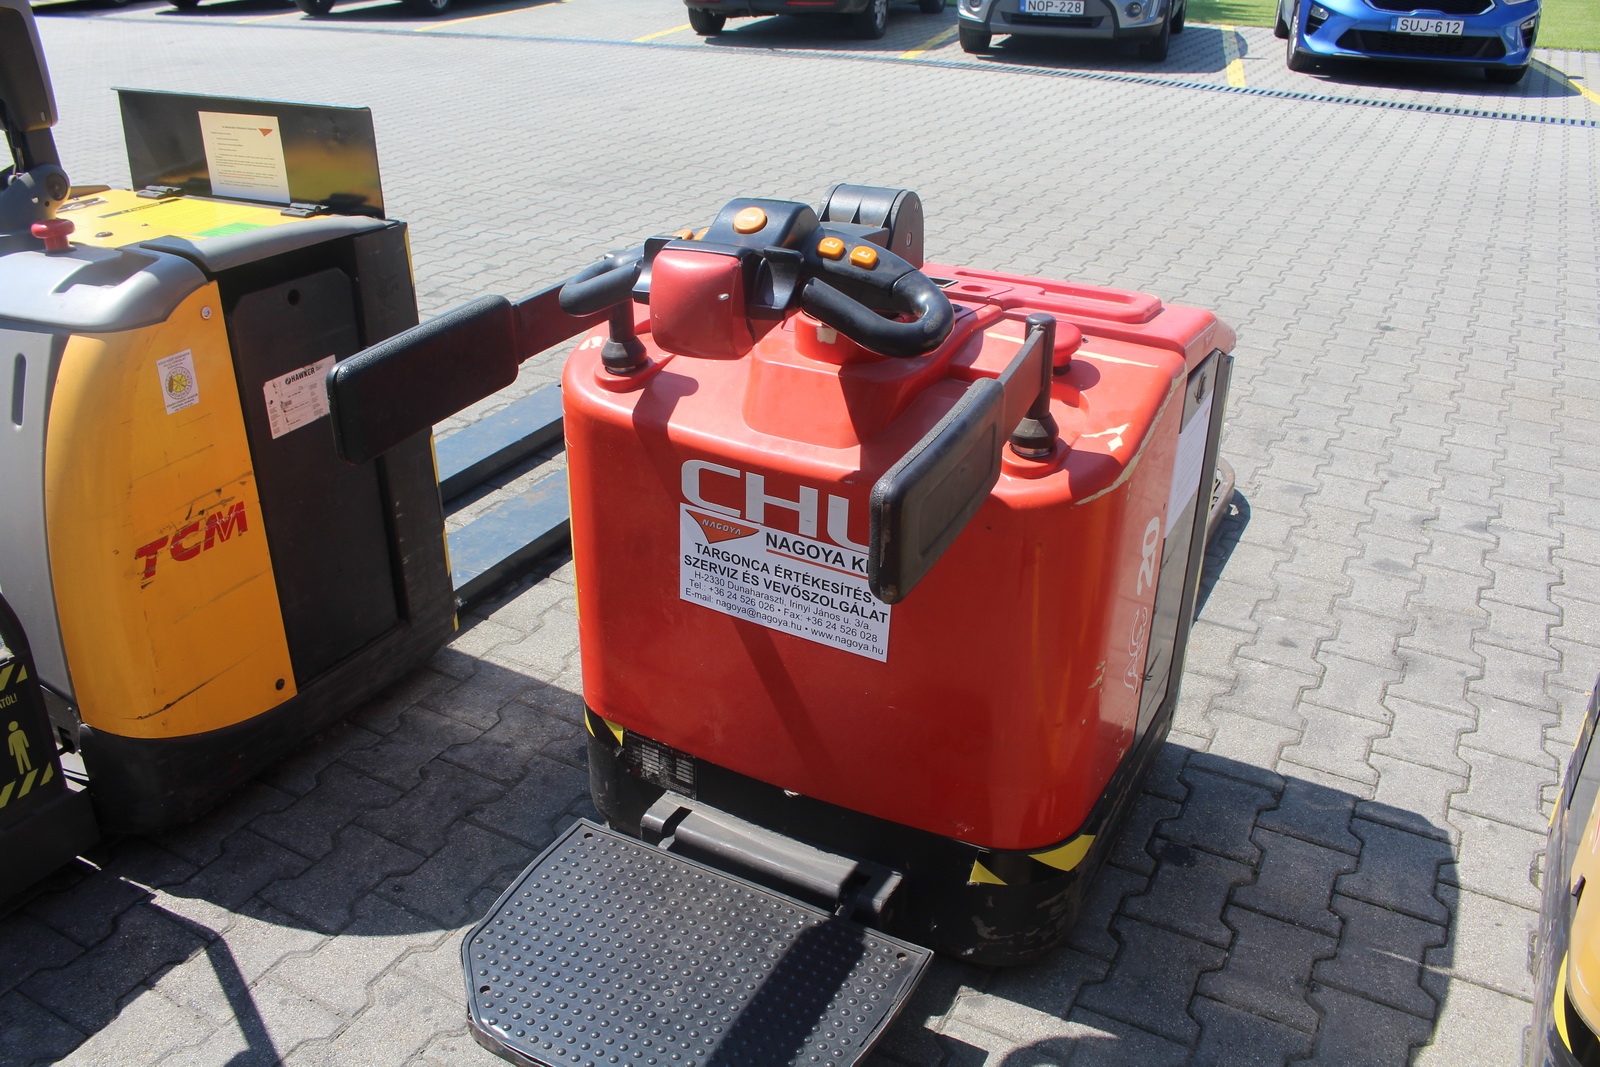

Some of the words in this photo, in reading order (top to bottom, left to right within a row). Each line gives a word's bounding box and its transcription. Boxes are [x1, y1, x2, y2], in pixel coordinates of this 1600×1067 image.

[1028, 0, 1081, 13] NOP-228
[1400, 19, 1460, 34] SUJ-612
[291, 367, 315, 383] HAWKER
[134, 501, 248, 580] TCM
[702, 519, 741, 536] NAGOYA
[766, 532, 846, 567] NAGOYA
[684, 554, 738, 580] SZERVIZ
[742, 570, 759, 587] ÉS
[695, 542, 770, 574] TARGONCA
[775, 564, 876, 606] ÉRTÉKESÍTÉS,
[1137, 516, 1160, 596] 20
[685, 587, 714, 603] E-mail:
[716, 598, 802, 631] nagoya@nagoya.hu
[811, 628, 884, 655] www.nagoya.hu
[689, 578, 706, 591] Tel.:
[709, 586, 725, 597] +36
[727, 590, 737, 601] 24
[740, 594, 756, 606] 526
[758, 600, 775, 612] 026
[783, 608, 803, 621] Fax:
[806, 616, 823, 627] +36
[825, 620, 837, 631] 24
[840, 625, 857, 637] 526
[860, 630, 878, 643] 028
[694, 571, 725, 587] H-2330
[727, 581, 787, 606] Dunaharaszti,
[789, 599, 811, 613] Irinyi
[813, 607, 840, 621] János
[843, 617, 851, 625] u.
[855, 619, 872, 631] 3/a.
